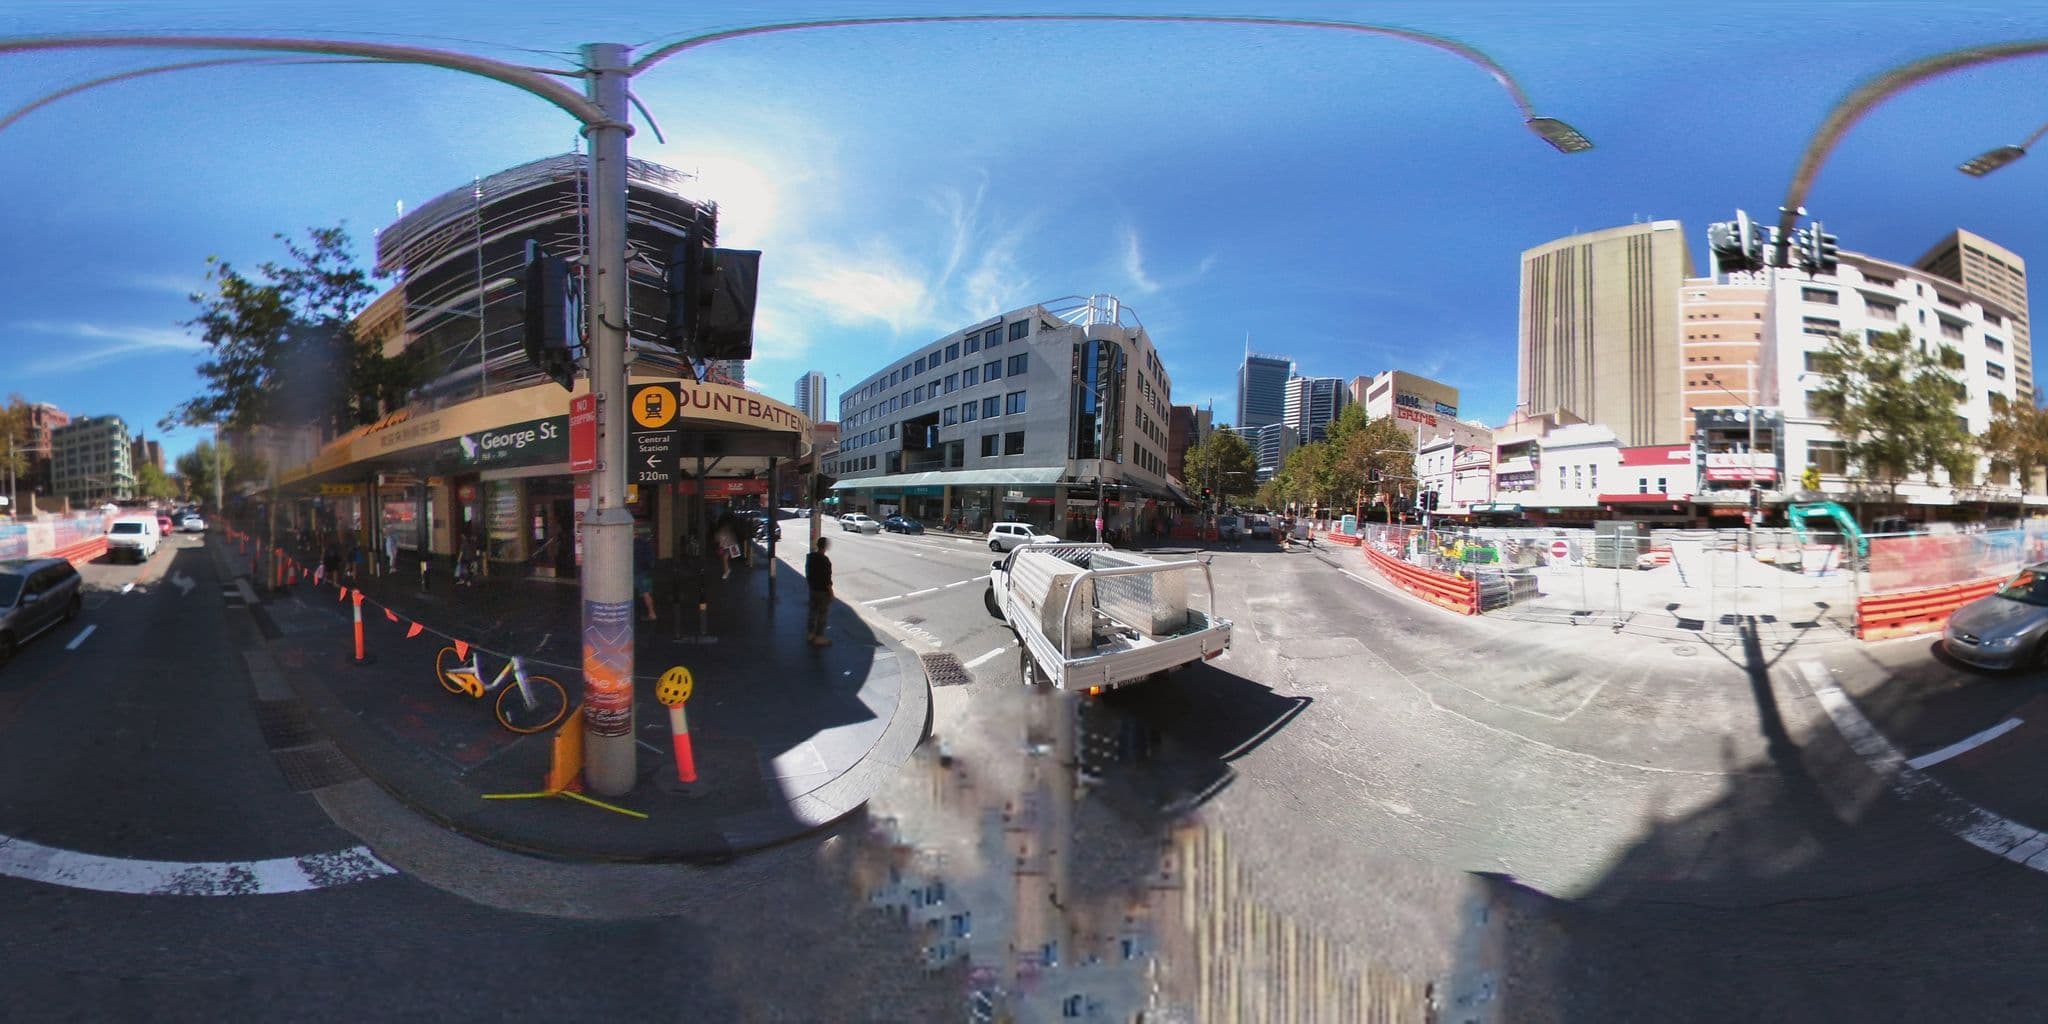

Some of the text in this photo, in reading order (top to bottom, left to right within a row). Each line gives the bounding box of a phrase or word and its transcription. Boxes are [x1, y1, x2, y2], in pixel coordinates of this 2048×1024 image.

[576, 399, 588, 412] NO
[481, 422, 558, 449] George St
[638, 435, 670, 444] Central
[639, 444, 669, 453] Station
[639, 471, 669, 481] 320m
